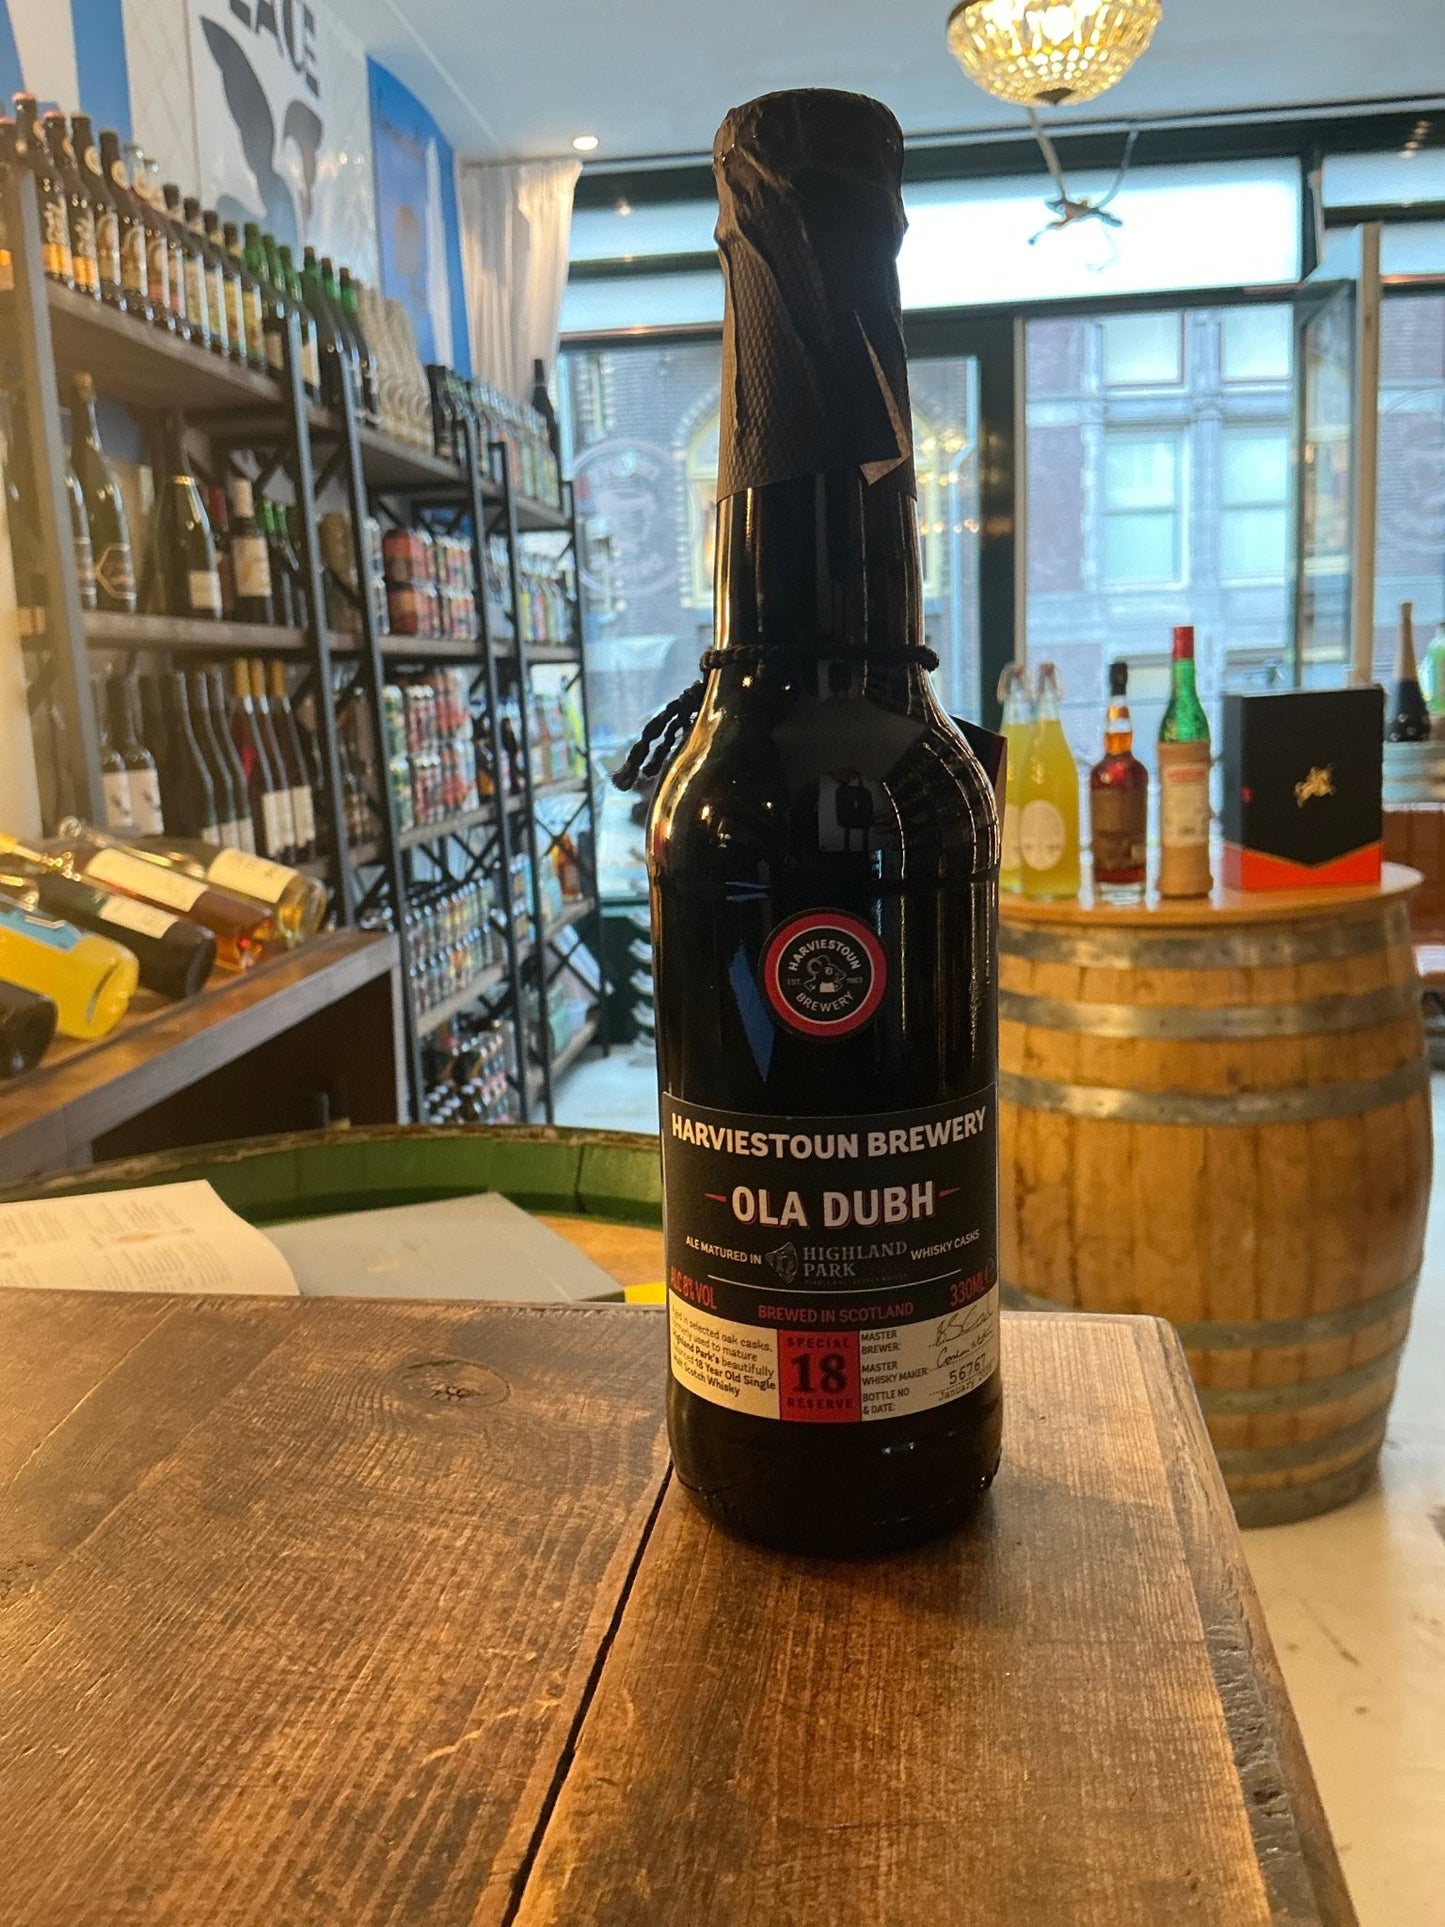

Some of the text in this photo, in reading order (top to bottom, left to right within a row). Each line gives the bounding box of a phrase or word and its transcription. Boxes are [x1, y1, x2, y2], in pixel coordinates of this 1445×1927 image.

[788, 939, 861, 972] HARVIESTOUN
[796, 990, 854, 1012] BREWERY
[671, 1106, 986, 1160] HARVIESTOUN BREWERY
[732, 1180, 935, 1229] OLA DUBH
[686, 1236, 762, 1265] ALE MATURED IN
[803, 1241, 907, 1261] HIGHLAND
[910, 1229, 980, 1261] WHISKY CASKS
[803, 1262, 856, 1278] PARK
[696, 1281, 717, 1309] VOL
[758, 1302, 914, 1322] BREWED IN SCOTLAND
[721, 1334, 738, 1345] oak
[740, 1339, 773, 1352] casks,
[787, 1336, 851, 1349] SPECIAL
[861, 1330, 897, 1341] MASTER
[712, 1341, 721, 1352] to
[722, 1346, 758, 1361] mature
[861, 1342, 900, 1355] BREWER:
[695, 1358, 704, 1369] 18
[705, 1363, 723, 1377] Year
[725, 1370, 741, 1383] Old
[743, 1375, 776, 1391] Single
[721, 1358, 774, 1381] beautifully
[790, 1352, 848, 1394] 18
[862, 1361, 898, 1373] MASTER
[707, 1375, 741, 1397] Whisky
[862, 1373, 896, 1386] WHISKY
[787, 1396, 854, 1409] RESERVE
[862, 1387, 910, 1402] BOTTLE NO
[863, 1406, 870, 1415] &
